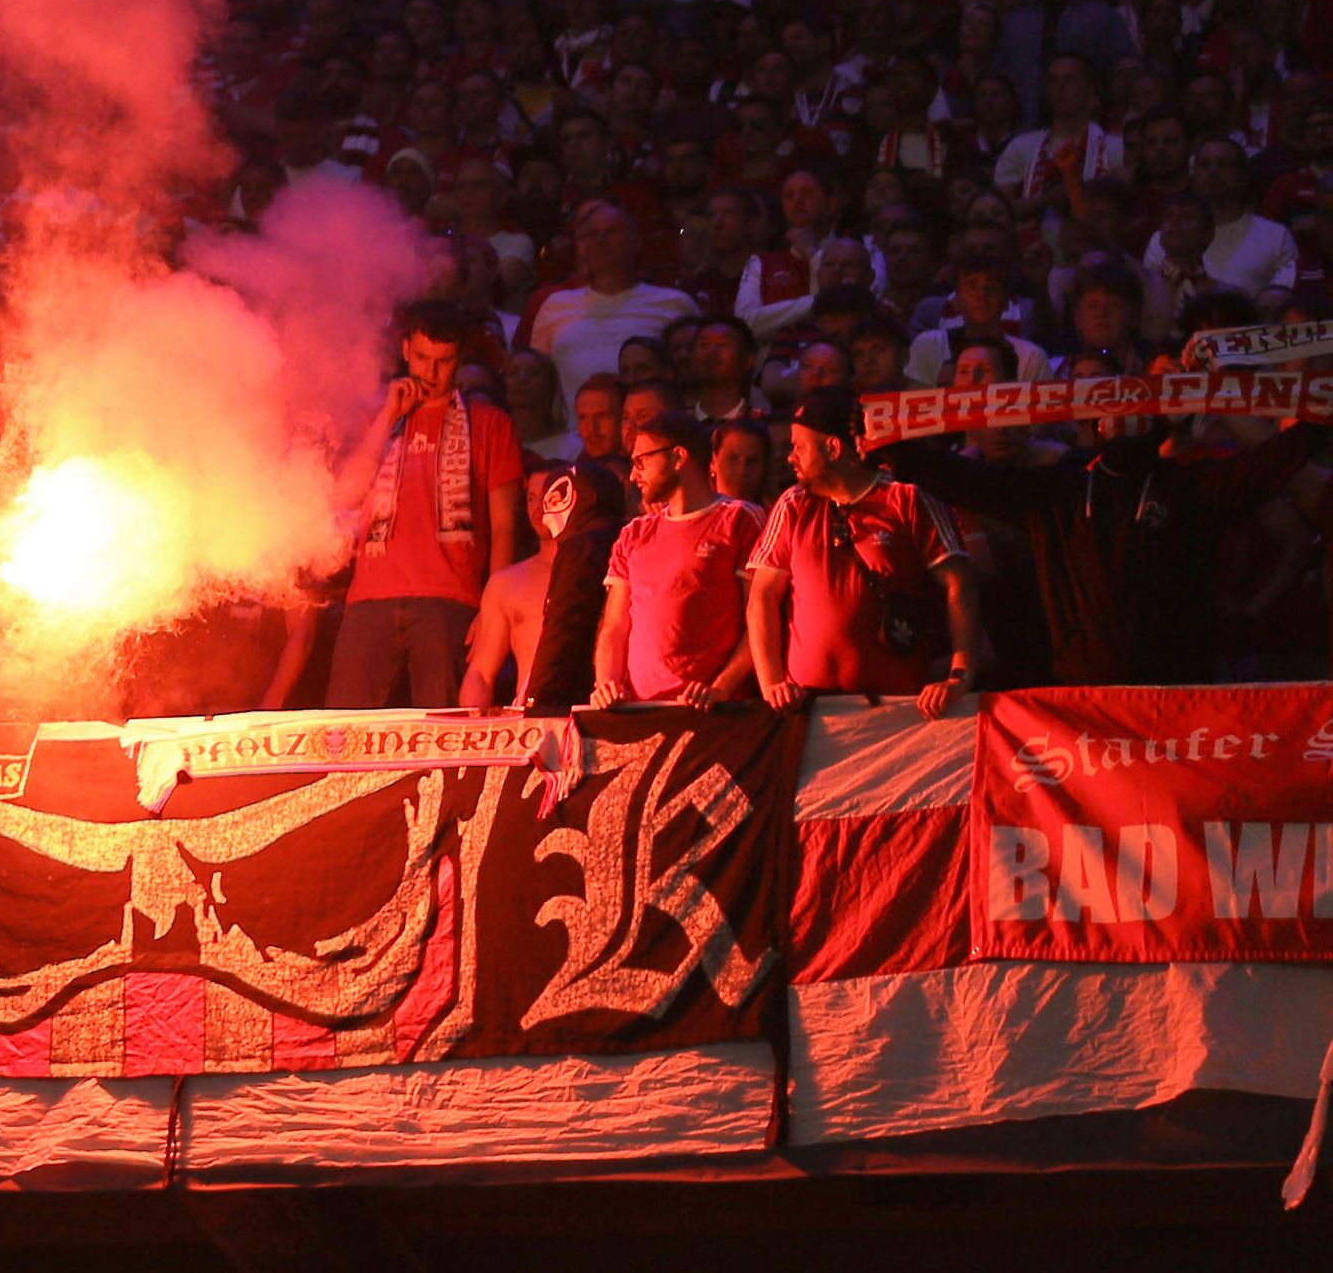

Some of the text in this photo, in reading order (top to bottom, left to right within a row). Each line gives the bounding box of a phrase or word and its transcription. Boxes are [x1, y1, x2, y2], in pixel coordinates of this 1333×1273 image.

[862, 381, 1071, 441] BETZE
[1163, 371, 1333, 418] FANS
[181, 726, 545, 763] PFALZ INFERNO
[1011, 725, 1282, 794] Staufer
[987, 822, 1179, 924] BAD
